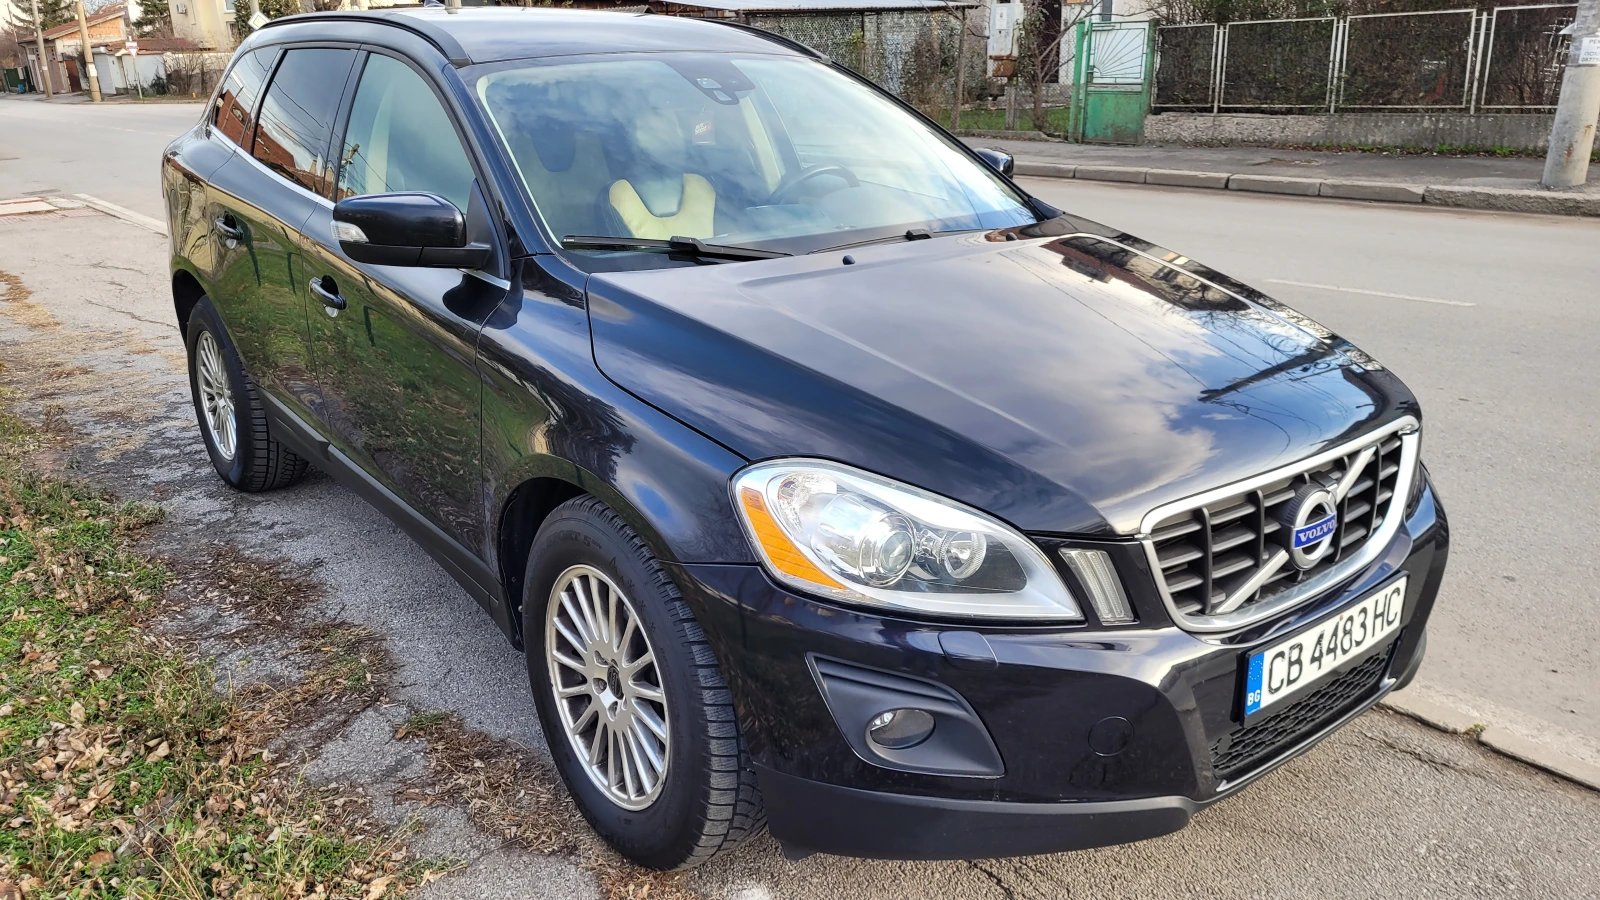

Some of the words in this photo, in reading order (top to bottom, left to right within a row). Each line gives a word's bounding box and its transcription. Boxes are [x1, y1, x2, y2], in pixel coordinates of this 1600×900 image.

[1298, 519, 1335, 542] VOLVO
[1267, 642, 1304, 695] CB
[1309, 606, 1368, 671] 4483
[1371, 586, 1401, 638] HC
[1247, 690, 1261, 706] BG
